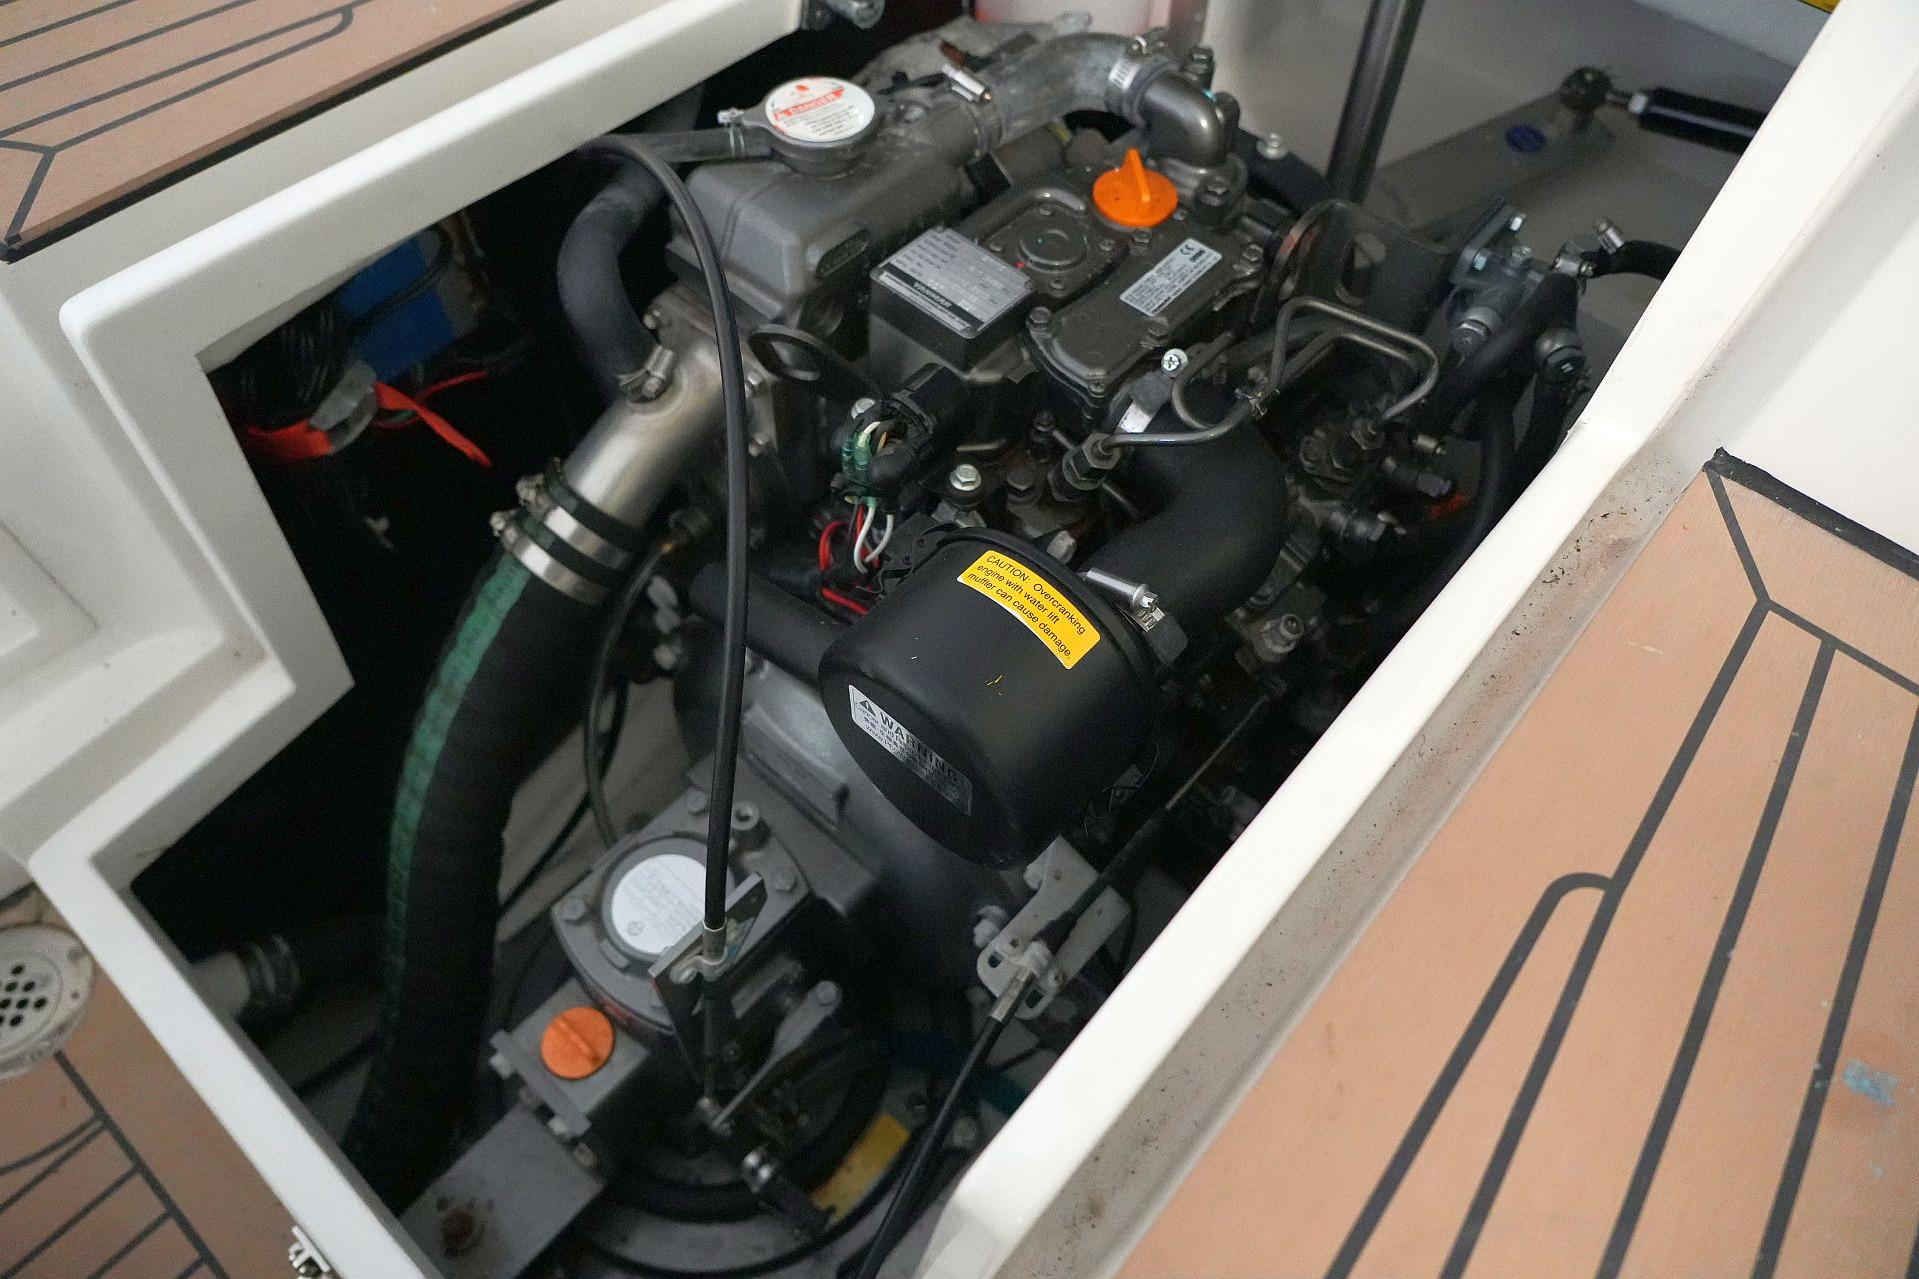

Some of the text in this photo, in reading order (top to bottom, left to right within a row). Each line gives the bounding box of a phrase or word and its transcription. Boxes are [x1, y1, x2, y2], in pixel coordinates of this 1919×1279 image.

[967, 572, 1072, 660] muffler can cause damage.
[976, 564, 1061, 625] engine with water lift
[986, 555, 1086, 635] CAUTION: Overcranking
[880, 711, 958, 783] WARNING
